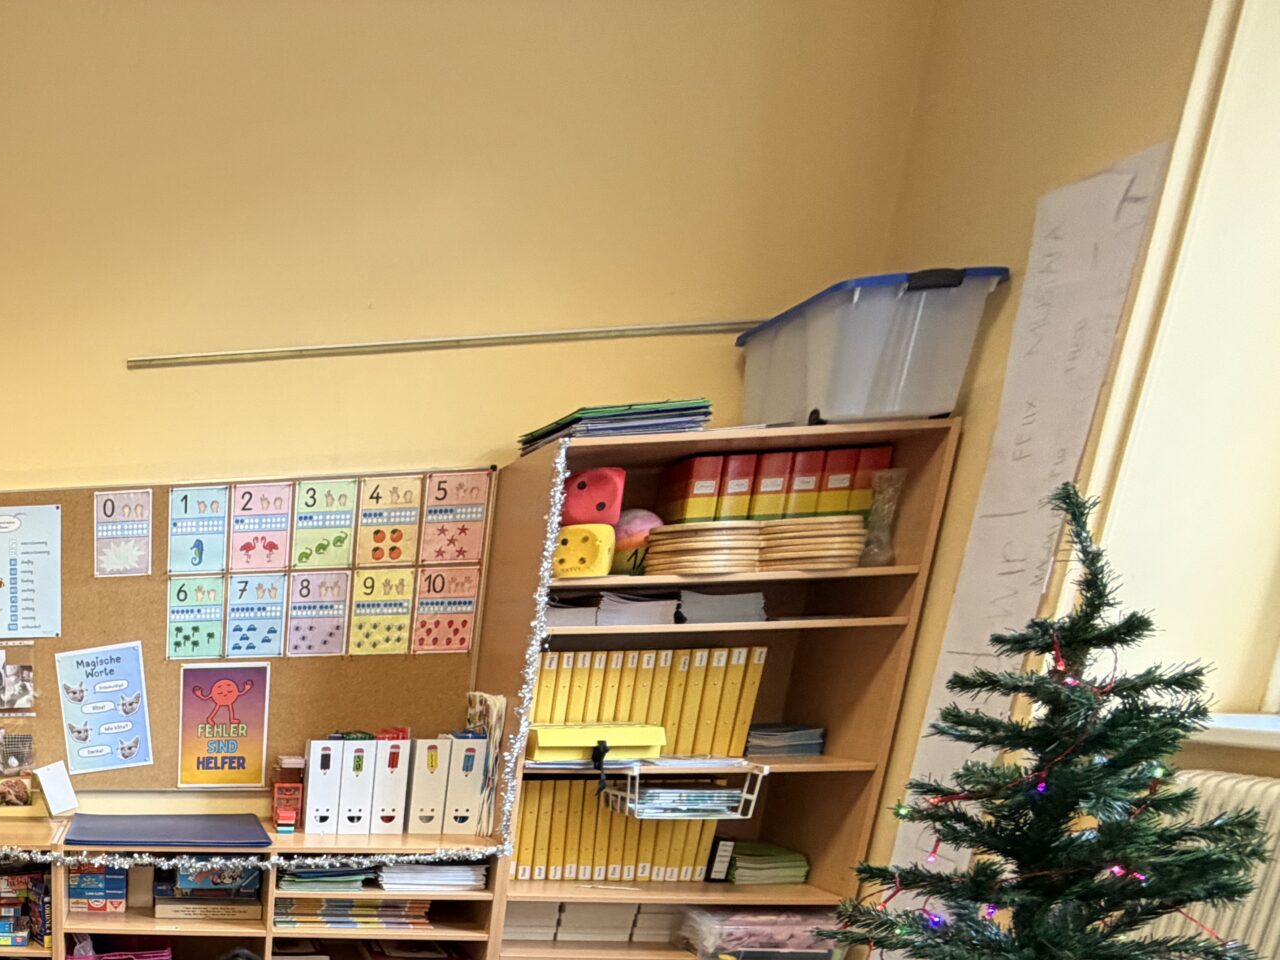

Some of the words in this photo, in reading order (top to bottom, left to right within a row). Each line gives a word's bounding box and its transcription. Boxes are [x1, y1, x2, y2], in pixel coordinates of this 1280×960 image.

[303, 487, 317, 508] 3
[368, 485, 383, 504] 4
[434, 480, 448, 500] 5
[102, 498, 115, 518] 0
[180, 494, 189, 514] 1
[240, 491, 253, 511] 2
[175, 582, 188, 602] 6
[236, 581, 249, 602] 7
[299, 578, 311, 598] 8
[362, 576, 375, 595] 9
[424, 574, 445, 594] 10
[76, 655, 122, 671] Magische
[85, 668, 115, 679] Worte
[197, 723, 248, 738] FEHLER
[207, 740, 238, 754] SIND
[196, 756, 247, 770] HELFER
